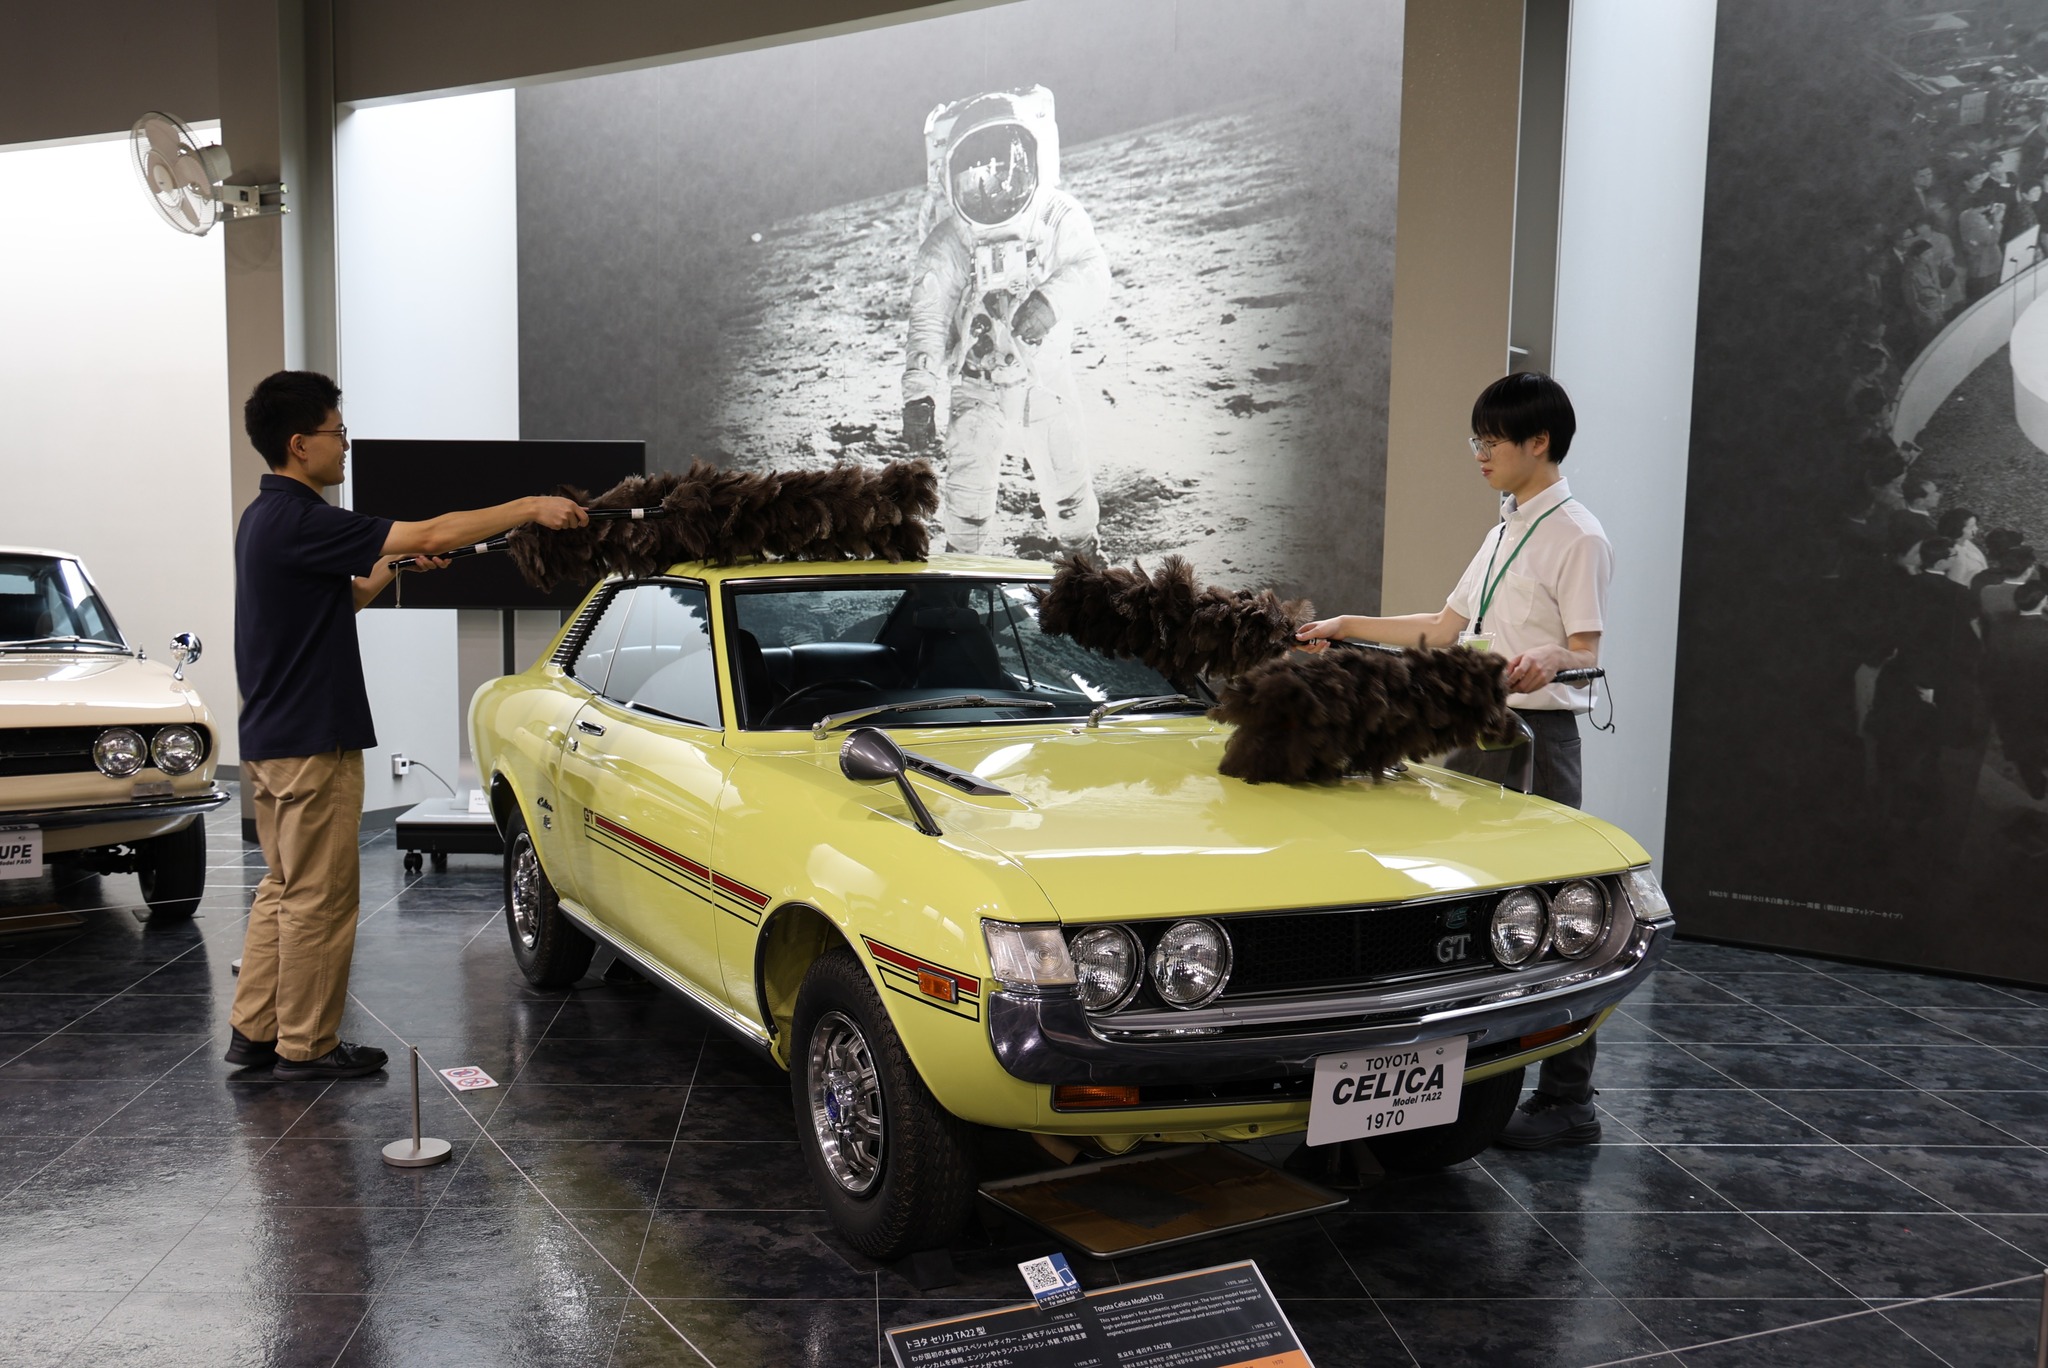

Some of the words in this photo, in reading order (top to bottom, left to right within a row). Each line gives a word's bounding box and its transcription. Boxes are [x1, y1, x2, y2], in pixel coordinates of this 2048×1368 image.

[584, 808, 594, 824] GT
[1437, 934, 1472, 963] GT
[1366, 1052, 1420, 1072] TOYOTA
[1332, 1064, 1444, 1106] CELICA
[1392, 1097, 1418, 1107] Model
[1420, 1092, 1442, 1102] TA22
[1366, 1110, 1404, 1130] 1970
[1131, 1296, 1150, 1305] Model
[906, 1338, 928, 1349] トヨタ
[930, 1334, 954, 1344] セリカ
